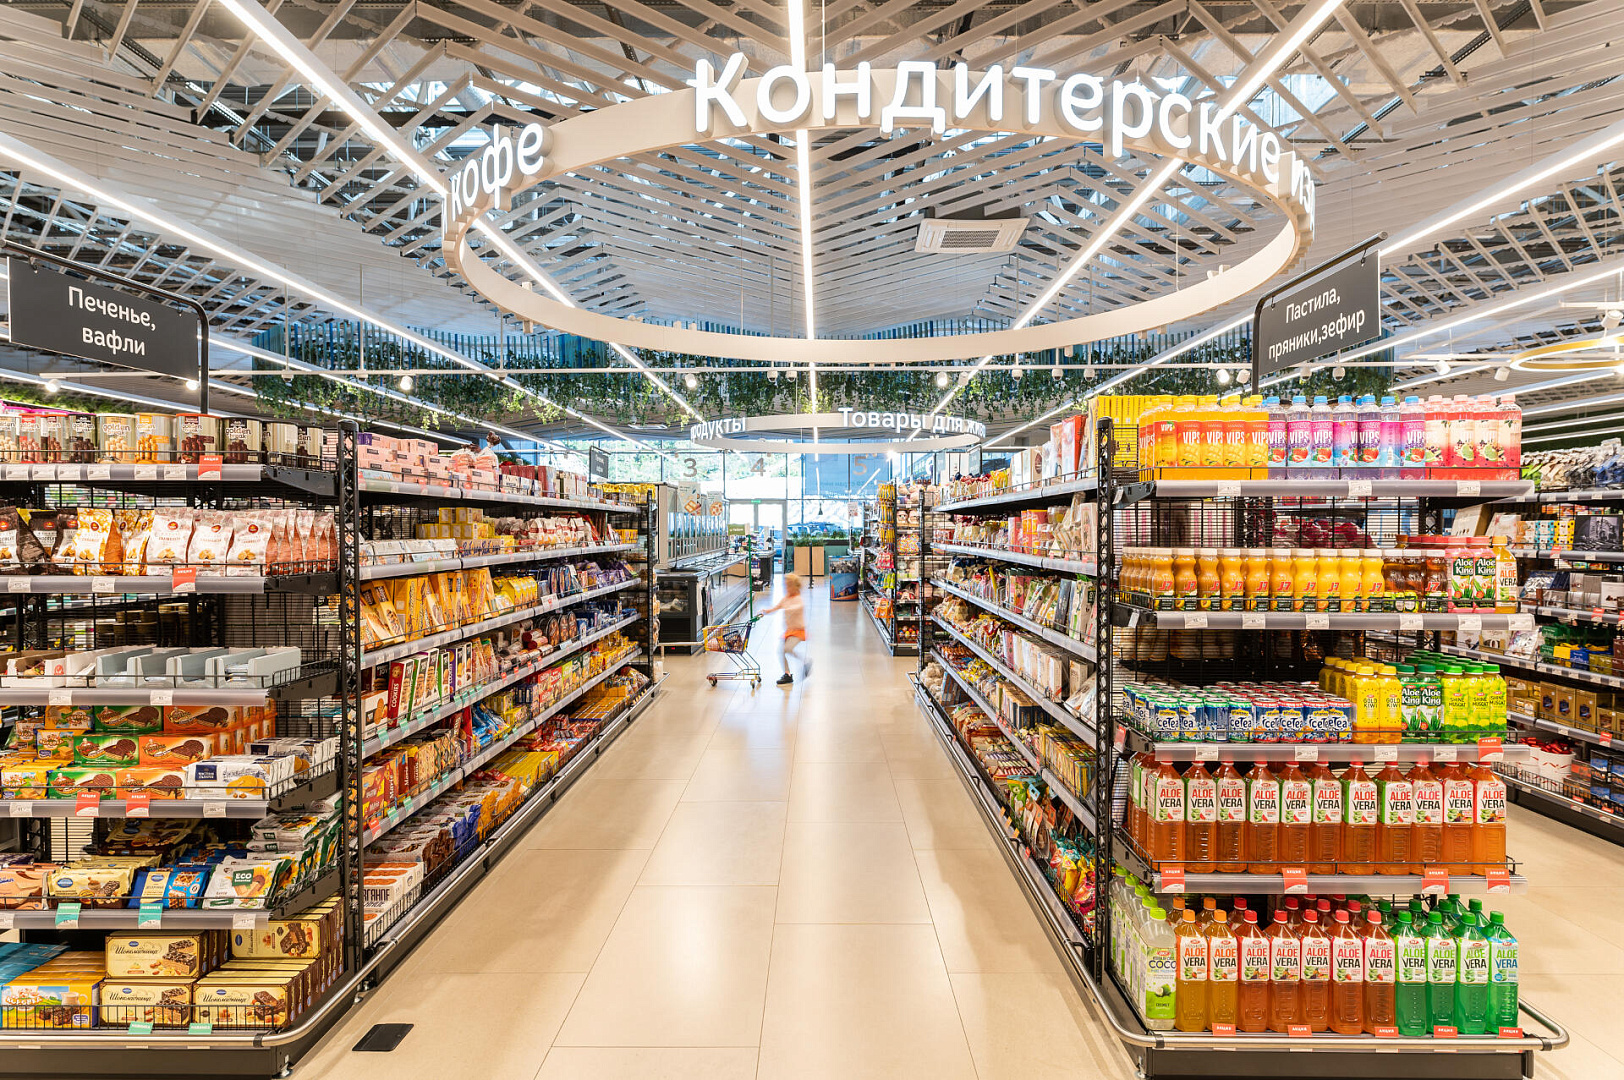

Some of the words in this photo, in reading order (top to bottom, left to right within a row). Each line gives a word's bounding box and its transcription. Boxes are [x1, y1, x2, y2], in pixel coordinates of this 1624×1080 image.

[695, 52, 1280, 184] Кондитерские
[452, 122, 544, 221] кофе
[68, 285, 156, 331] Печенье,
[1285, 287, 1341, 324] Пастила,
[1268, 308, 1366, 362] пряники,зефир
[82, 326, 146, 356] вафли
[838, 407, 925, 434] Товары
[932, 415, 963, 434] для
[103, 424, 131, 433] golden
[226, 427, 251, 435] golden
[1161, 424, 1173, 432] VIPS
[1226, 431, 1245, 445] VIPS
[1289, 431, 1309, 444] VIPS
[1360, 431, 1380, 445] VIPS
[682, 457, 697, 478] 3
[750, 457, 767, 477] 4
[853, 456, 867, 475] 5
[1455, 566, 1473, 575] King
[1477, 566, 1496, 575] King
[1500, 570, 1517, 578] ALOE
[1158, 581, 1173, 590] J7
[1184, 581, 1197, 590] J7
[1231, 581, 1244, 590] J7
[1256, 581, 1269, 591] J7
[1277, 581, 1292, 591] J7
[1303, 581, 1316, 591] J7
[1327, 582, 1339, 592] J7
[1369, 582, 1382, 592] J7
[1425, 582, 1440, 591] J7
[1499, 578, 1516, 586] VERA
[391, 683, 399, 708] COOKIES
[1401, 688, 1420, 696] Aloe
[1422, 688, 1441, 696] Aloe
[1401, 696, 1420, 706] King
[1422, 696, 1441, 706] King
[1160, 788, 1182, 798] ALOE
[1192, 788, 1213, 798] ALOE
[1221, 788, 1242, 798] ALOE
[1254, 790, 1276, 799] ALOE
[1286, 790, 1307, 799] ALOE
[1317, 789, 1340, 800] ALOE
[1353, 790, 1376, 800] ALOE
[1390, 790, 1411, 800] ALOE
[1416, 790, 1440, 801] ALOE
[1449, 789, 1472, 799] ALOE
[1482, 790, 1504, 800] ALOE
[1159, 797, 1182, 807] VERA
[1191, 798, 1214, 808] VERA
[1219, 797, 1243, 807] VERA
[1253, 799, 1277, 809] VERA
[1285, 799, 1306, 809] VERA
[1316, 799, 1340, 810] VERA
[1352, 800, 1376, 810] VERA
[1388, 800, 1411, 811] VERA
[1414, 799, 1440, 810] VERA
[1448, 799, 1473, 809] VERA
[1480, 799, 1505, 809] VERA
[1184, 948, 1206, 957] ALOE
[1214, 948, 1237, 957] ALOE
[1246, 948, 1268, 957] ALOE
[1276, 948, 1298, 958] ALOE
[1306, 948, 1328, 957] ALOE
[1337, 948, 1360, 958] ALOE
[1369, 948, 1392, 958] ALOE
[1403, 948, 1425, 957] ALOE
[1433, 949, 1455, 958] ALOE
[1466, 948, 1485, 959] ALOE
[1496, 949, 1518, 958] ALOE
[1148, 960, 1177, 969] COCO
[1183, 957, 1206, 967] VERA
[1212, 957, 1237, 967] VERA
[1245, 957, 1268, 966] VERA
[1275, 957, 1299, 967] VERA
[1305, 956, 1328, 966] VERA
[1336, 958, 1361, 968] VERA
[1368, 958, 1392, 969] VERA
[1401, 957, 1425, 968] VERA
[1431, 958, 1455, 968] VERA
[1464, 959, 1487, 969] VERA
[1494, 958, 1518, 969] VERA
